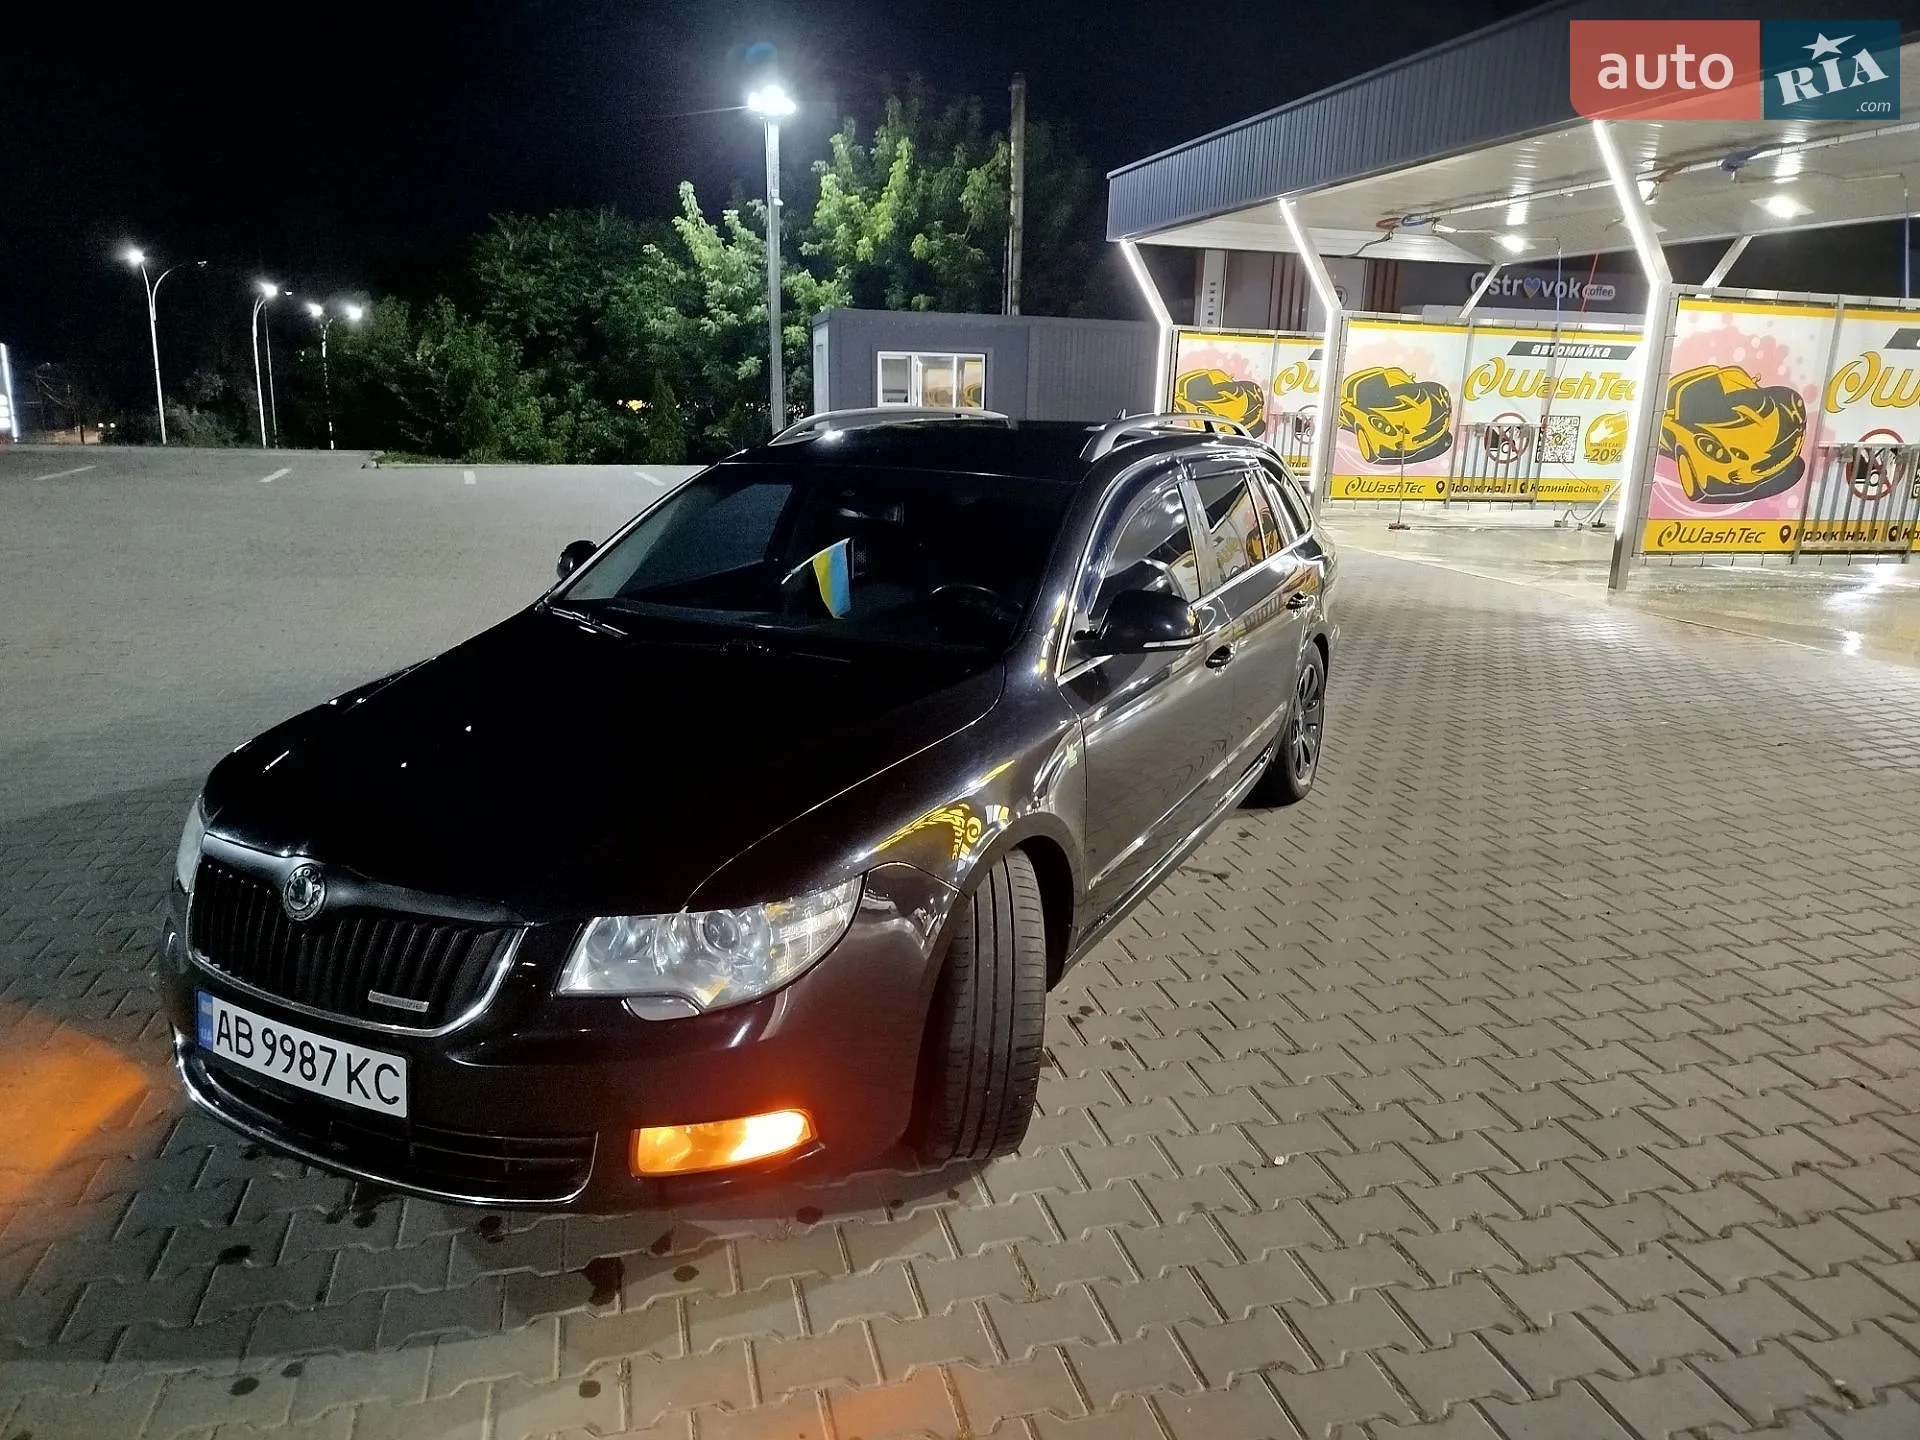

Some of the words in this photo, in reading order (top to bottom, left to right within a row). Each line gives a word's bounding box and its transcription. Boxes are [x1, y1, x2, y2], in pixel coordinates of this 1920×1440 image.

[216, 1009, 254, 1059] AB
[261, 1026, 337, 1087] 9987
[346, 1052, 400, 1105] KC
